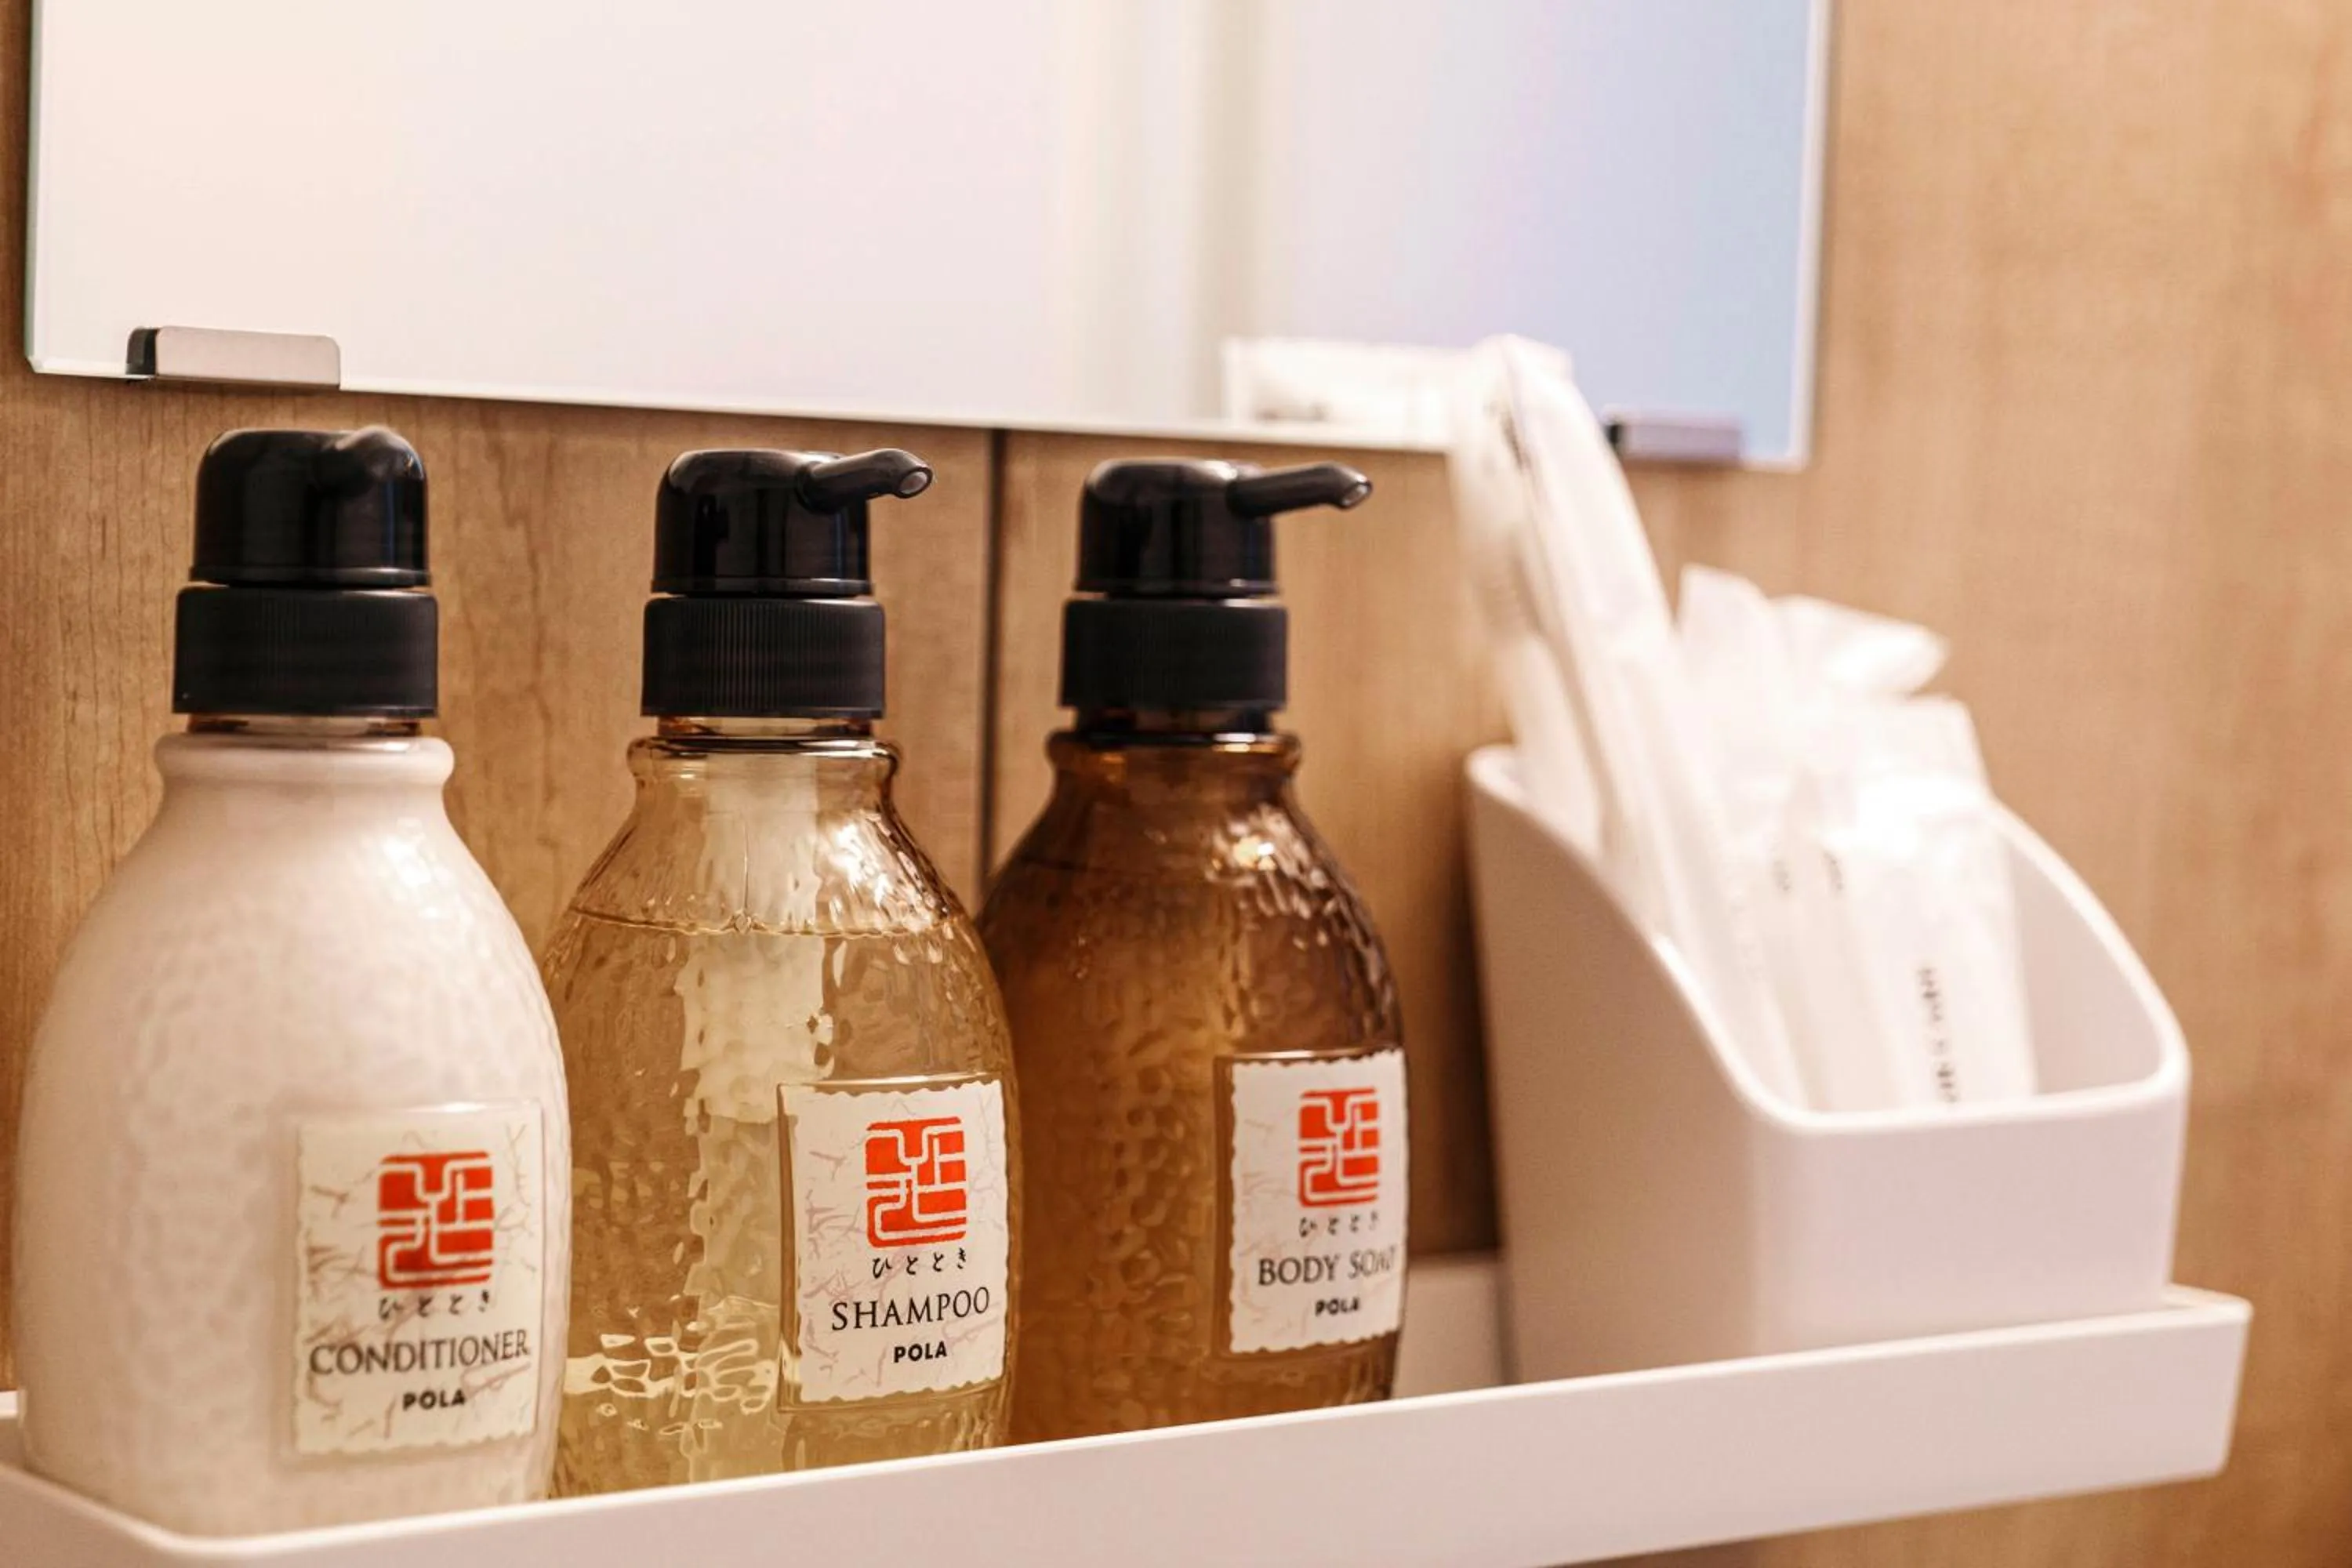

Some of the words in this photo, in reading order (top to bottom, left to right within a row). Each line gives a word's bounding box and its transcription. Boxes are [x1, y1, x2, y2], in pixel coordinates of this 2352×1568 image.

[873, 1247, 967, 1279] ひととき
[1258, 1254, 1340, 1287] BODY
[378, 1289, 490, 1320] ひととき
[831, 1286, 991, 1332] SHAMPOO
[1315, 1295, 1361, 1317] POLA
[309, 1328, 532, 1376] CONDITIONER
[893, 1341, 948, 1363] POLA
[402, 1388, 467, 1411] POLA
